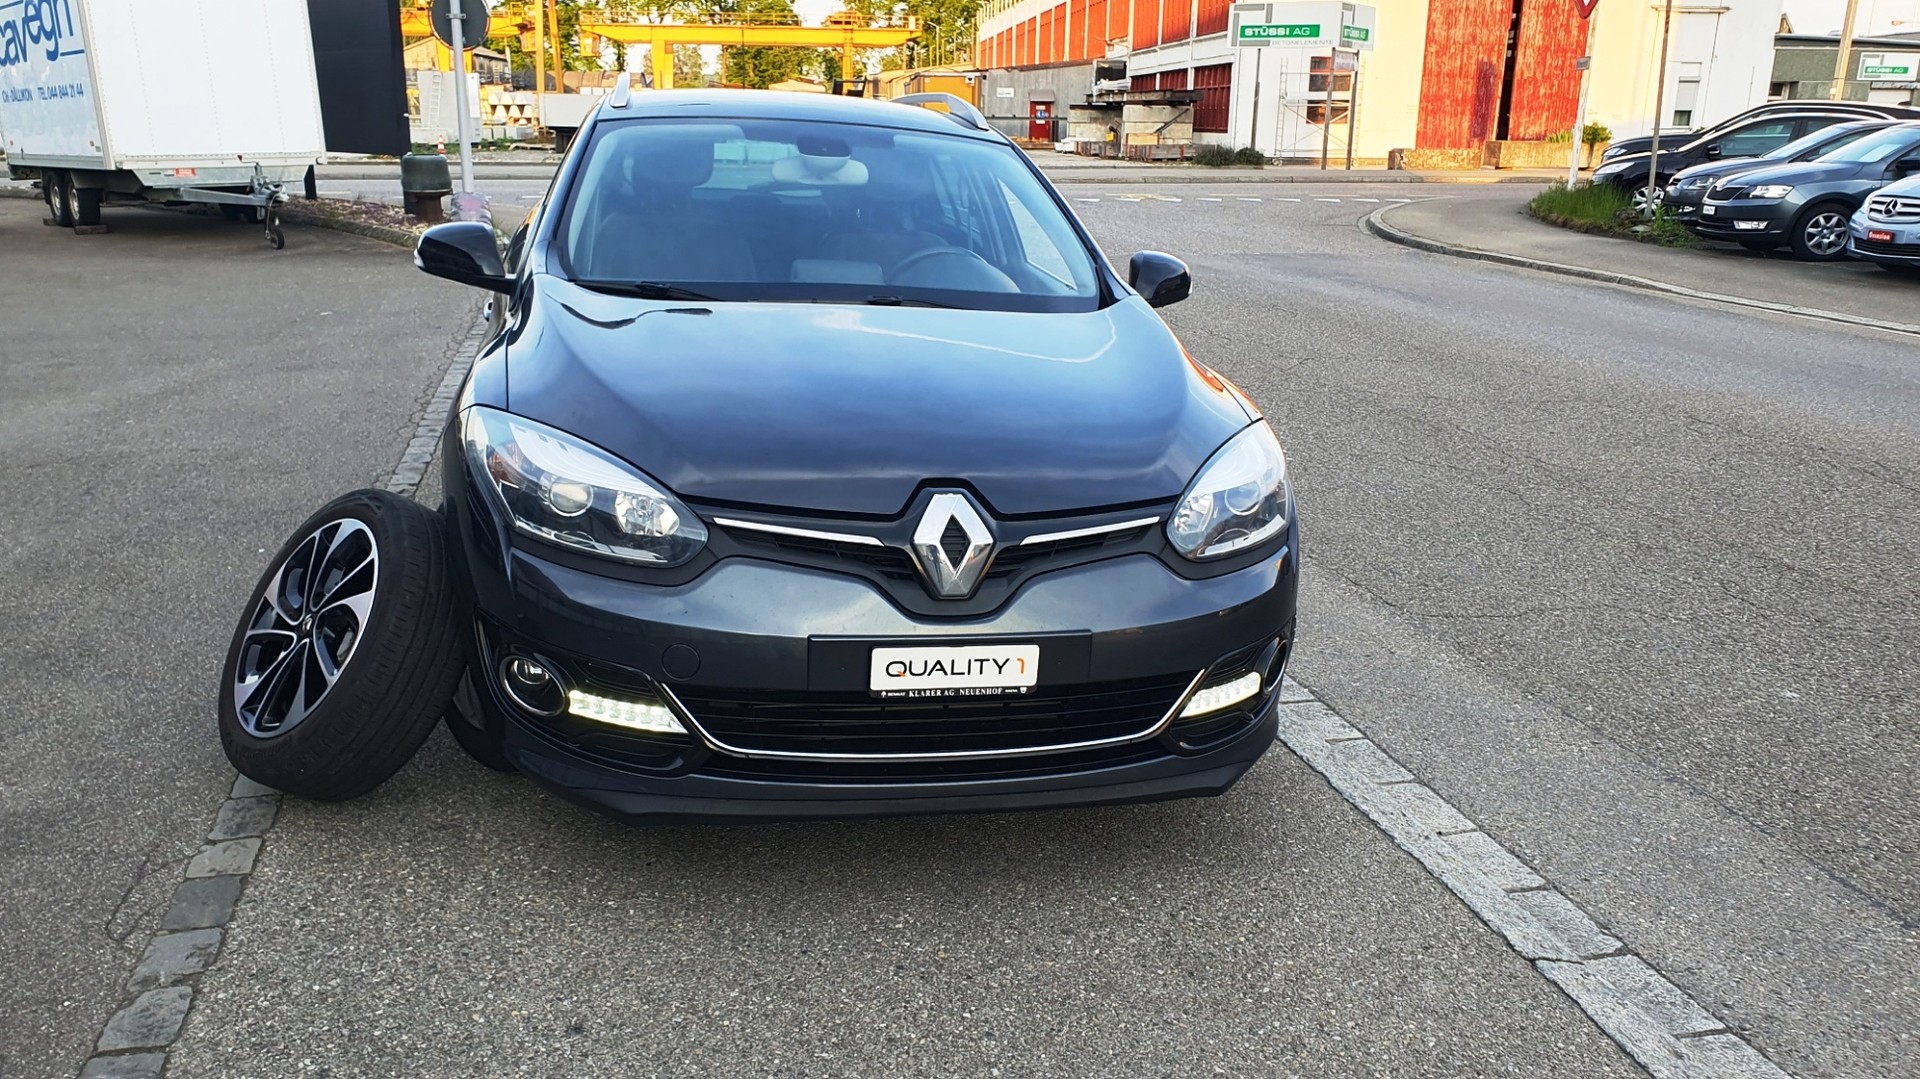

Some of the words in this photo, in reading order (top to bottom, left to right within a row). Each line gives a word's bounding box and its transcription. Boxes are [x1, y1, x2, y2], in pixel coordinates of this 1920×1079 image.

[1245, 26, 1290, 36] STÜSSI
[1293, 27, 1310, 36] AG
[886, 658, 1010, 678] QUALITY
[1016, 658, 1025, 674] 1
[908, 689, 941, 697] KLARER
[943, 688, 955, 696] AG
[959, 687, 1003, 696] NEUENHOF
